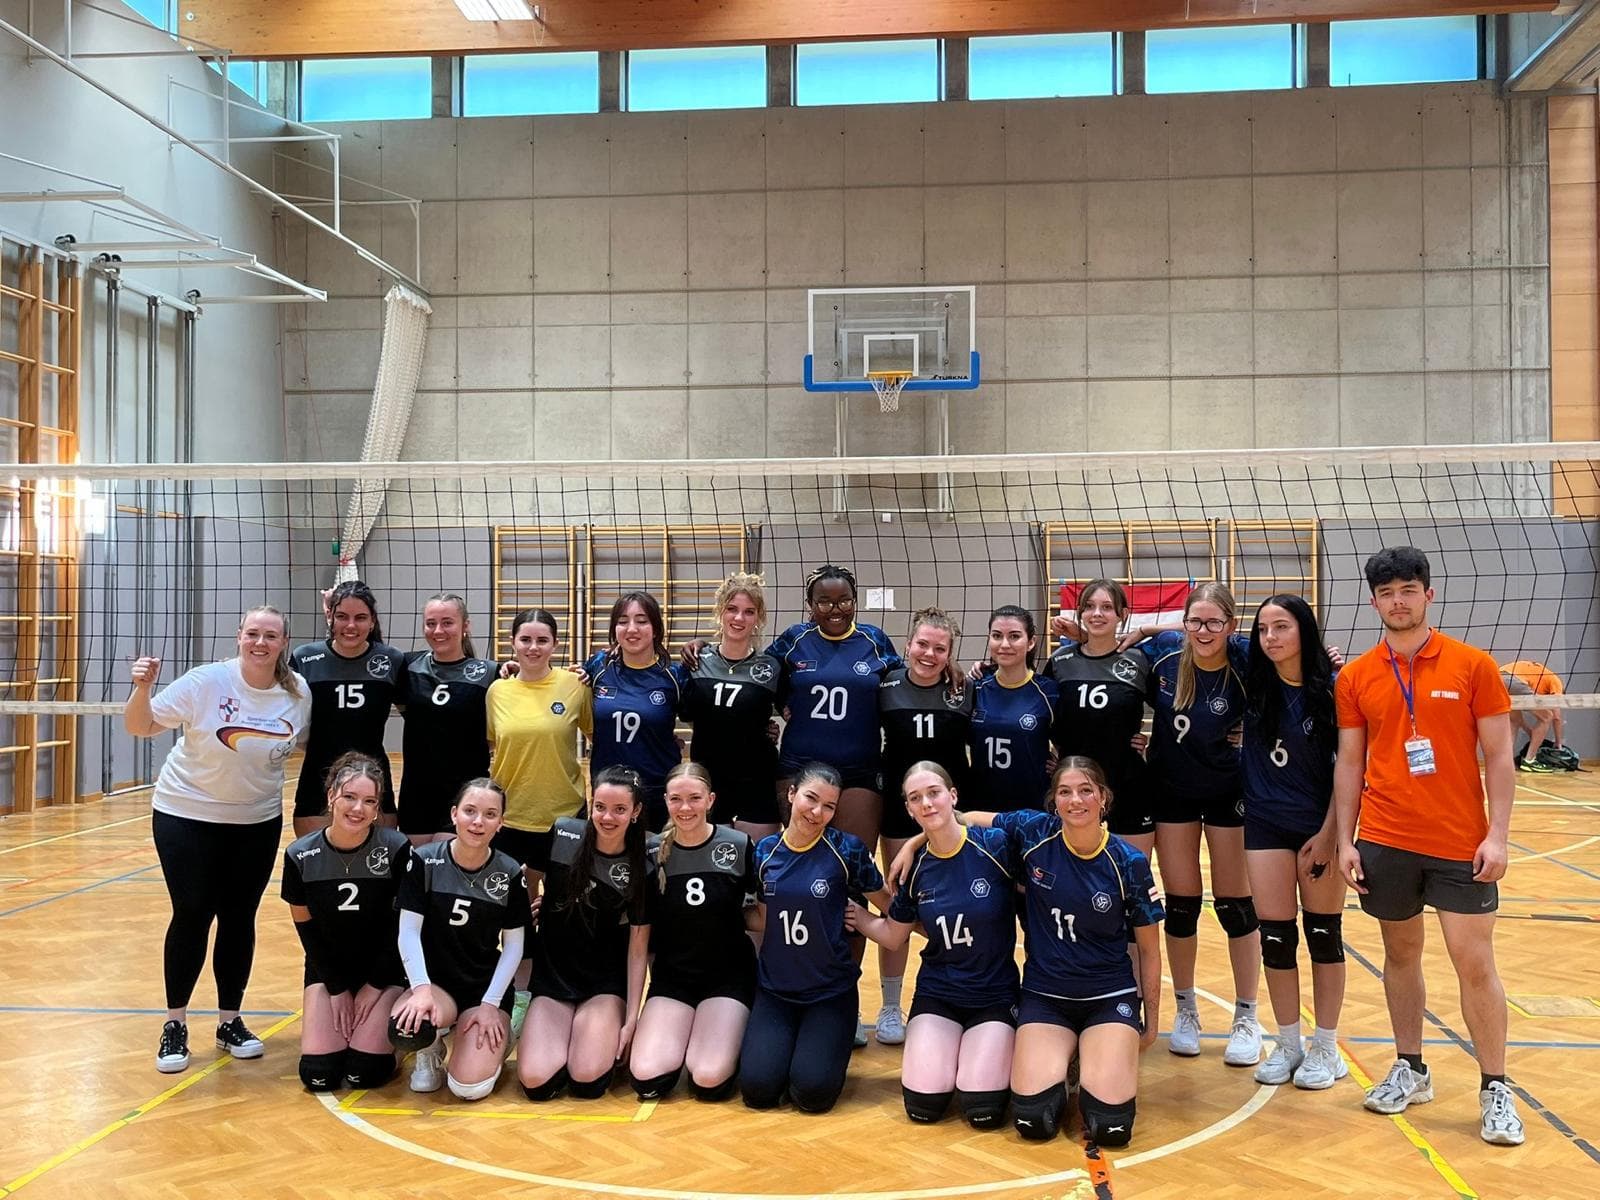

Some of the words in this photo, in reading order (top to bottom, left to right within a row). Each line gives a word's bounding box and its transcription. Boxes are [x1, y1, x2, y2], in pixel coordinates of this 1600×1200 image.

[335, 684, 365, 708] 15
[432, 681, 450, 705] 6
[714, 680, 745, 707] 17
[811, 685, 847, 720] 20
[1078, 684, 1108, 708] 16
[613, 711, 640, 742] 19
[913, 714, 934, 738] 11
[1174, 715, 1190, 743] 9
[985, 737, 1011, 768] 15
[1270, 739, 1288, 767] 6
[338, 883, 359, 910] 2
[686, 878, 705, 905] 8
[449, 899, 471, 925] 5
[1051, 908, 1076, 942] 11
[779, 911, 808, 945] 16
[936, 914, 973, 949] 14
